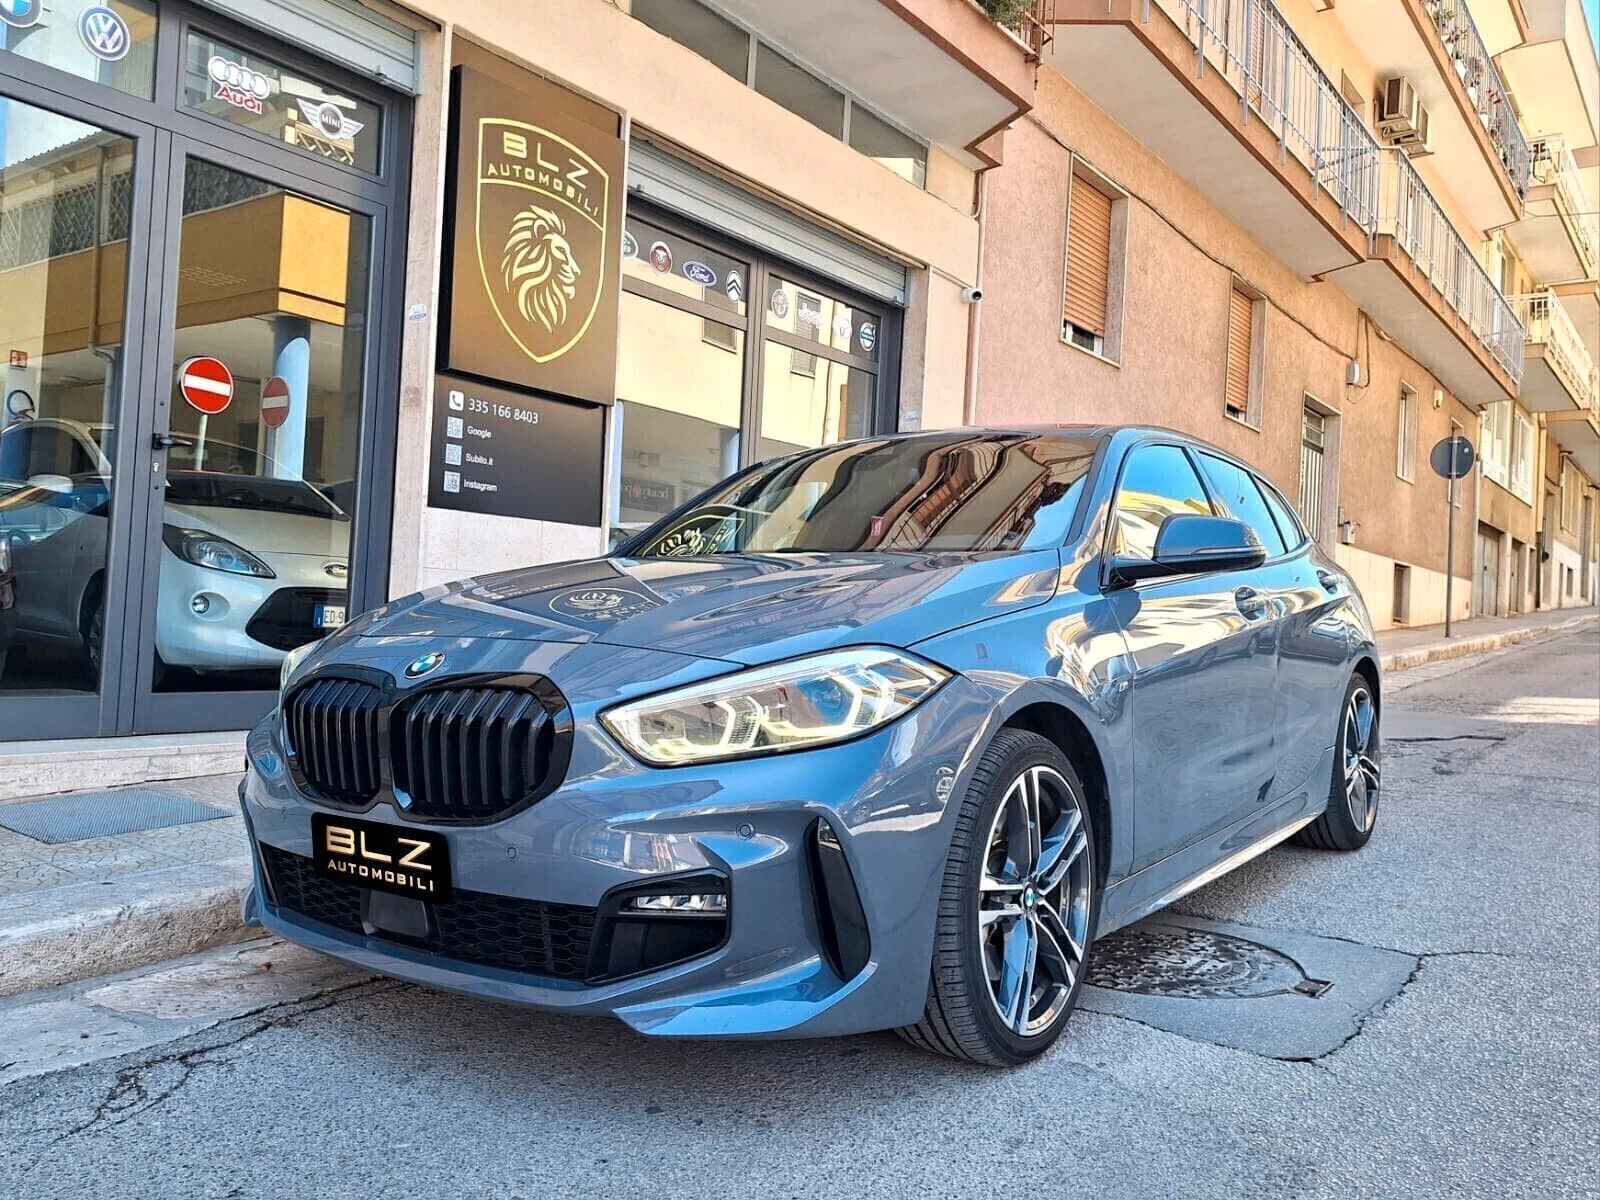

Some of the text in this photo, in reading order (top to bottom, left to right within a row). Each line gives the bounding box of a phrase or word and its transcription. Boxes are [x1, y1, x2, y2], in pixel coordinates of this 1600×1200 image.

[321, 113, 341, 129] MINI
[503, 131, 589, 190] BLZ
[487, 163, 599, 217] AUTOMOBILI
[690, 265, 710, 282] Ford
[468, 398, 539, 425] 335 166 8403
[466, 425, 492, 439] Google
[465, 452, 494, 466] Subito.it
[463, 479, 498, 492] Instagram
[326, 825, 432, 872] BLZ
[327, 858, 434, 893] AUTOMOBILI
